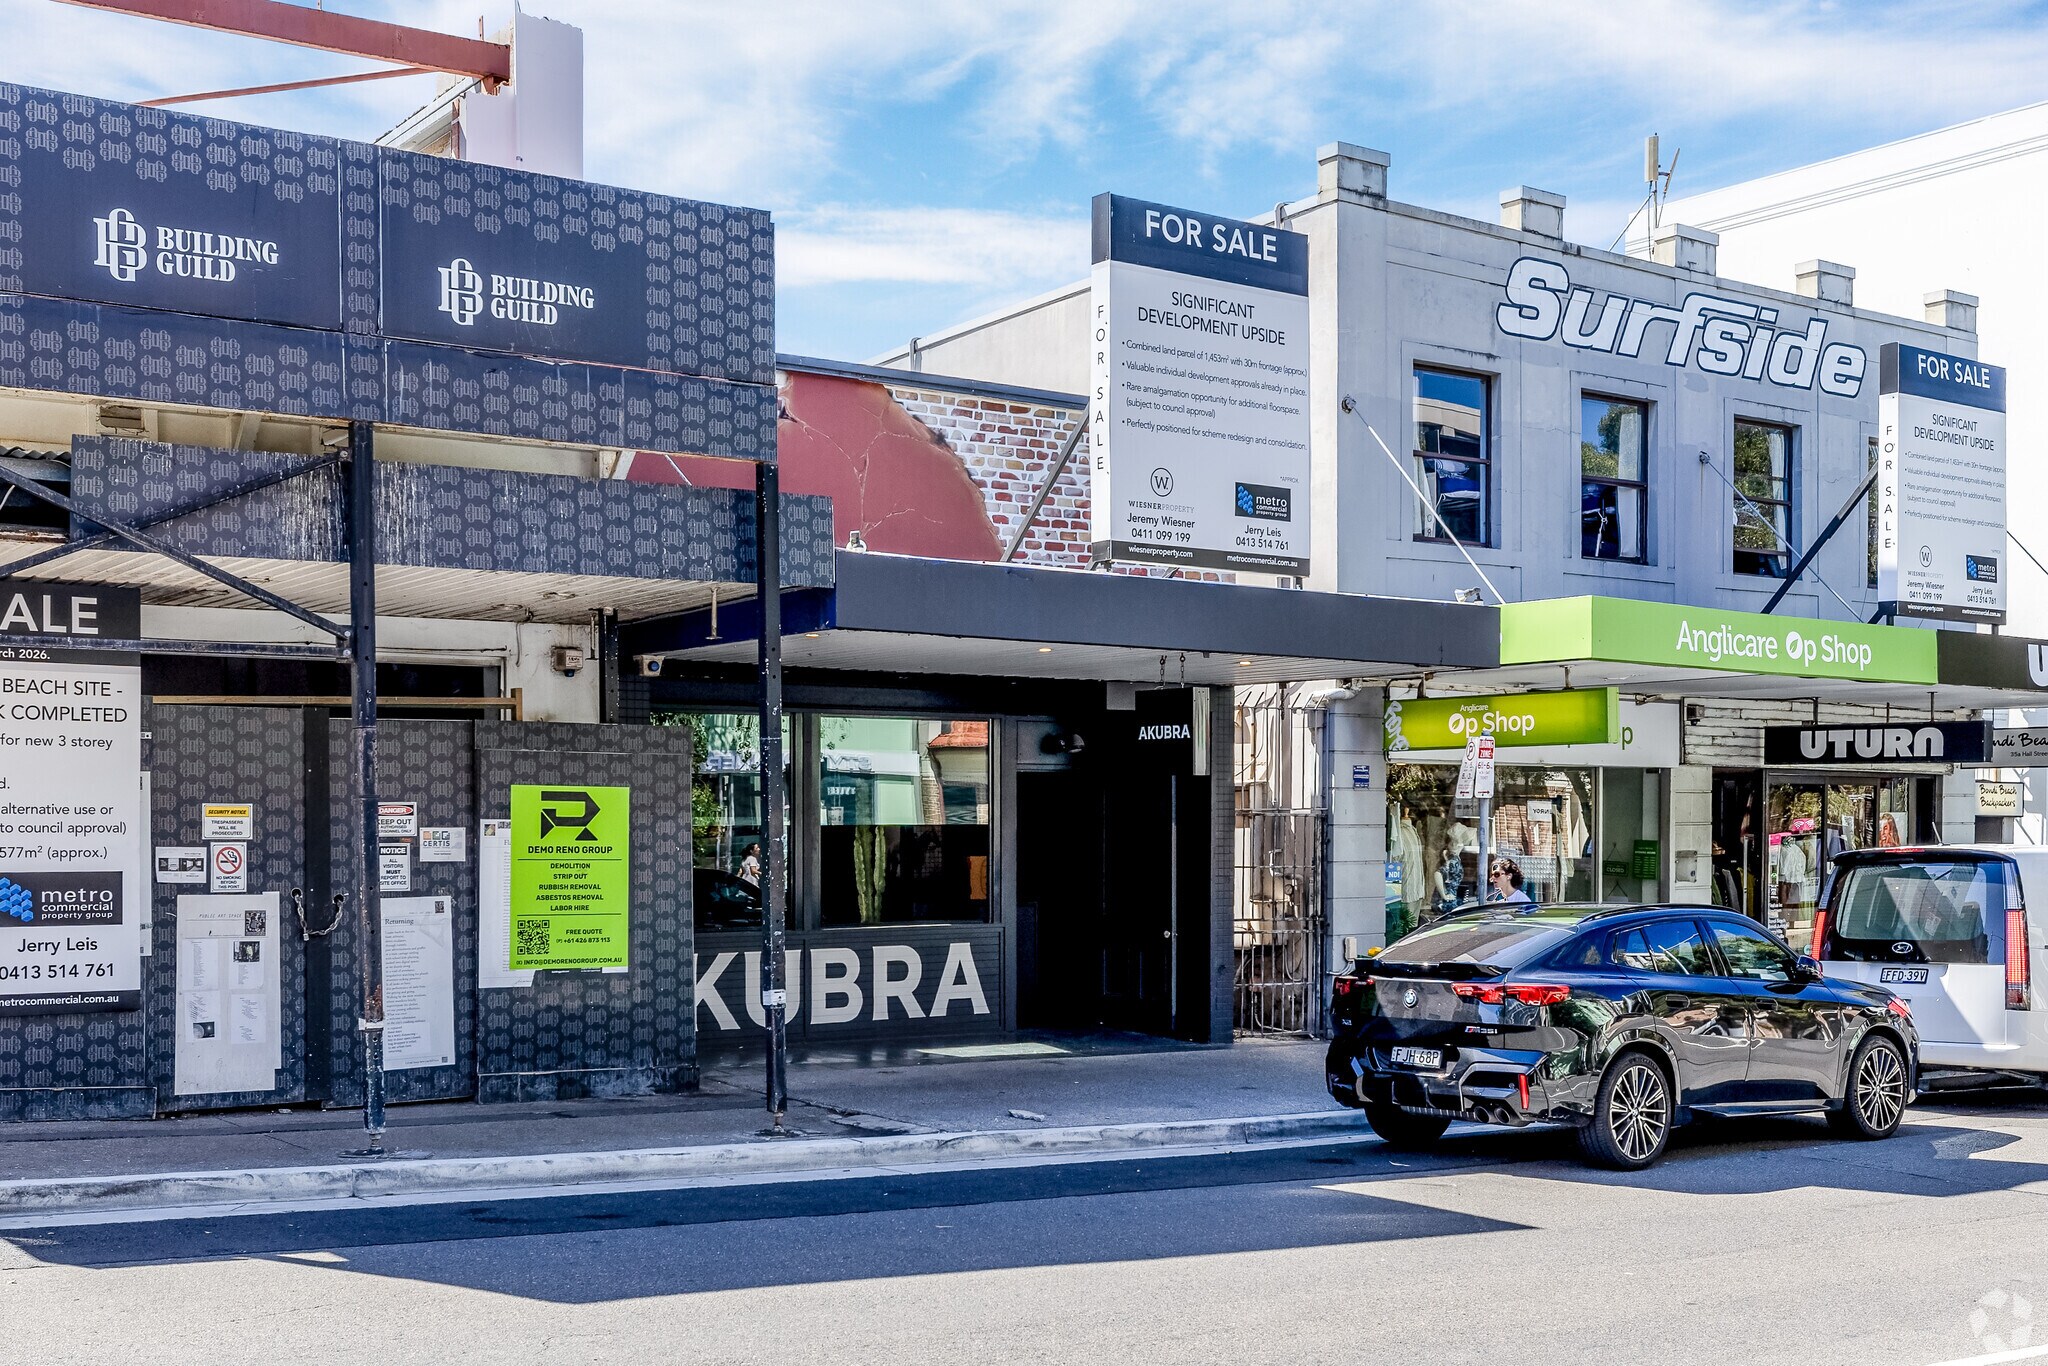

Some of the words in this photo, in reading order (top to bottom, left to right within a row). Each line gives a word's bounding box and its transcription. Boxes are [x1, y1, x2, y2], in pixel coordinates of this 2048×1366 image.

[1145, 210, 1202, 248] FOR
[1212, 224, 1277, 262] SALE
[157, 226, 279, 265] BUILDING
[156, 251, 236, 282] GUILD
[491, 274, 594, 309] BUILDING
[491, 297, 558, 325] GUILD
[1171, 291, 1255, 319] SIGNIFICANT
[1138, 306, 1238, 338] DEVELOPMENT
[1242, 325, 1286, 346] UPSIDE
[1496, 256, 1867, 399] Surfside
[1126, 339, 1160, 353] Combined
[1162, 344, 1175, 356] land
[1177, 350, 1195, 359] parcel
[1231, 357, 1243, 366] with
[1244, 358, 1258, 368] 30m
[1259, 360, 1282, 374] frontage
[1126, 360, 1154, 373] Valuable
[1156, 364, 1187, 378] individual
[1188, 370, 1230, 384] development
[1231, 378, 1260, 389] approvals
[1261, 381, 1282, 394] already
[1917, 353, 1950, 380] FOR
[1955, 361, 1991, 389] SALE
[1126, 381, 1142, 392] Rare
[1143, 385, 1189, 398] amalgamation
[1191, 393, 1227, 406] opportunity
[1229, 396, 1237, 405] for
[1238, 398, 1268, 410] additional
[1126, 397, 1152, 410] (subject
[1153, 402, 1161, 410] to
[1162, 404, 1185, 413] council
[1186, 407, 1216, 419] approval)
[1126, 418, 1155, 432] Perfectly
[1156, 423, 1190, 435] positioned
[1191, 426, 1201, 436] for
[1202, 429, 1227, 440] scheme
[1228, 432, 1254, 445] redesign
[1255, 436, 1267, 445] and
[1932, 413, 1978, 432] SIGNIFICANT
[1914, 427, 1968, 446] DEVELOPMENT
[1970, 436, 1994, 451] UPSIDE
[1256, 496, 1287, 507] metro
[1256, 504, 1287, 512] commercial
[1127, 512, 1159, 527] Jeremy
[1161, 516, 1196, 528] Wiesner
[1131, 528, 1153, 539] 0411
[1155, 530, 1173, 540] 099
[1175, 532, 1191, 542] 199
[1245, 524, 1265, 537] Jerry
[1267, 526, 1282, 537] Leis
[1128, 545, 1193, 558] wiesnerproperty.com
[1236, 536, 1256, 547] 0413
[1258, 538, 1272, 548] 514
[1275, 540, 1289, 550] 761
[1226, 555, 1298, 567] metrocommercial.com.au
[1977, 564, 1996, 573] metro
[19, 649, 50, 660] 2026.
[1676, 620, 1778, 662] Anglicare
[1785, 631, 1817, 667] Op
[1821, 635, 1872, 671] Shop
[3, 678, 67, 695] BEACH
[74, 681, 111, 697] SITE
[11, 705, 127, 722] COMPLETED
[1460, 704, 1489, 713] Anglicare
[1138, 724, 1191, 740] AKUBRA
[1448, 713, 1478, 738] Op
[1482, 711, 1535, 736] Shop
[0, 733, 20, 746] for
[26, 737, 53, 746] new
[59, 735, 66, 747] 3
[71, 736, 113, 751] storey
[1800, 728, 1944, 758] UTURN
[1980, 784, 1997, 795] Bondi
[1999, 784, 2017, 795] Beach
[1, 803, 70, 815] alternative
[74, 807, 96, 815] use
[100, 807, 114, 815] or
[1980, 796, 2016, 809] Backpackers
[0, 823, 13, 833] to
[18, 821, 62, 833] council
[67, 821, 127, 837] approval)
[48, 847, 108, 861] (approx.)
[528, 846, 554, 854] DEMO
[582, 846, 613, 854] GROUP
[41, 888, 113, 903] metro
[41, 901, 113, 912] commercial
[41, 912, 82, 920] property
[86, 911, 113, 919] group
[17, 938, 60, 956] Jerry
[67, 937, 98, 951] Leis
[0, 965, 41, 980] 0413
[48, 964, 79, 979] 514
[85, 962, 113, 977] 761
